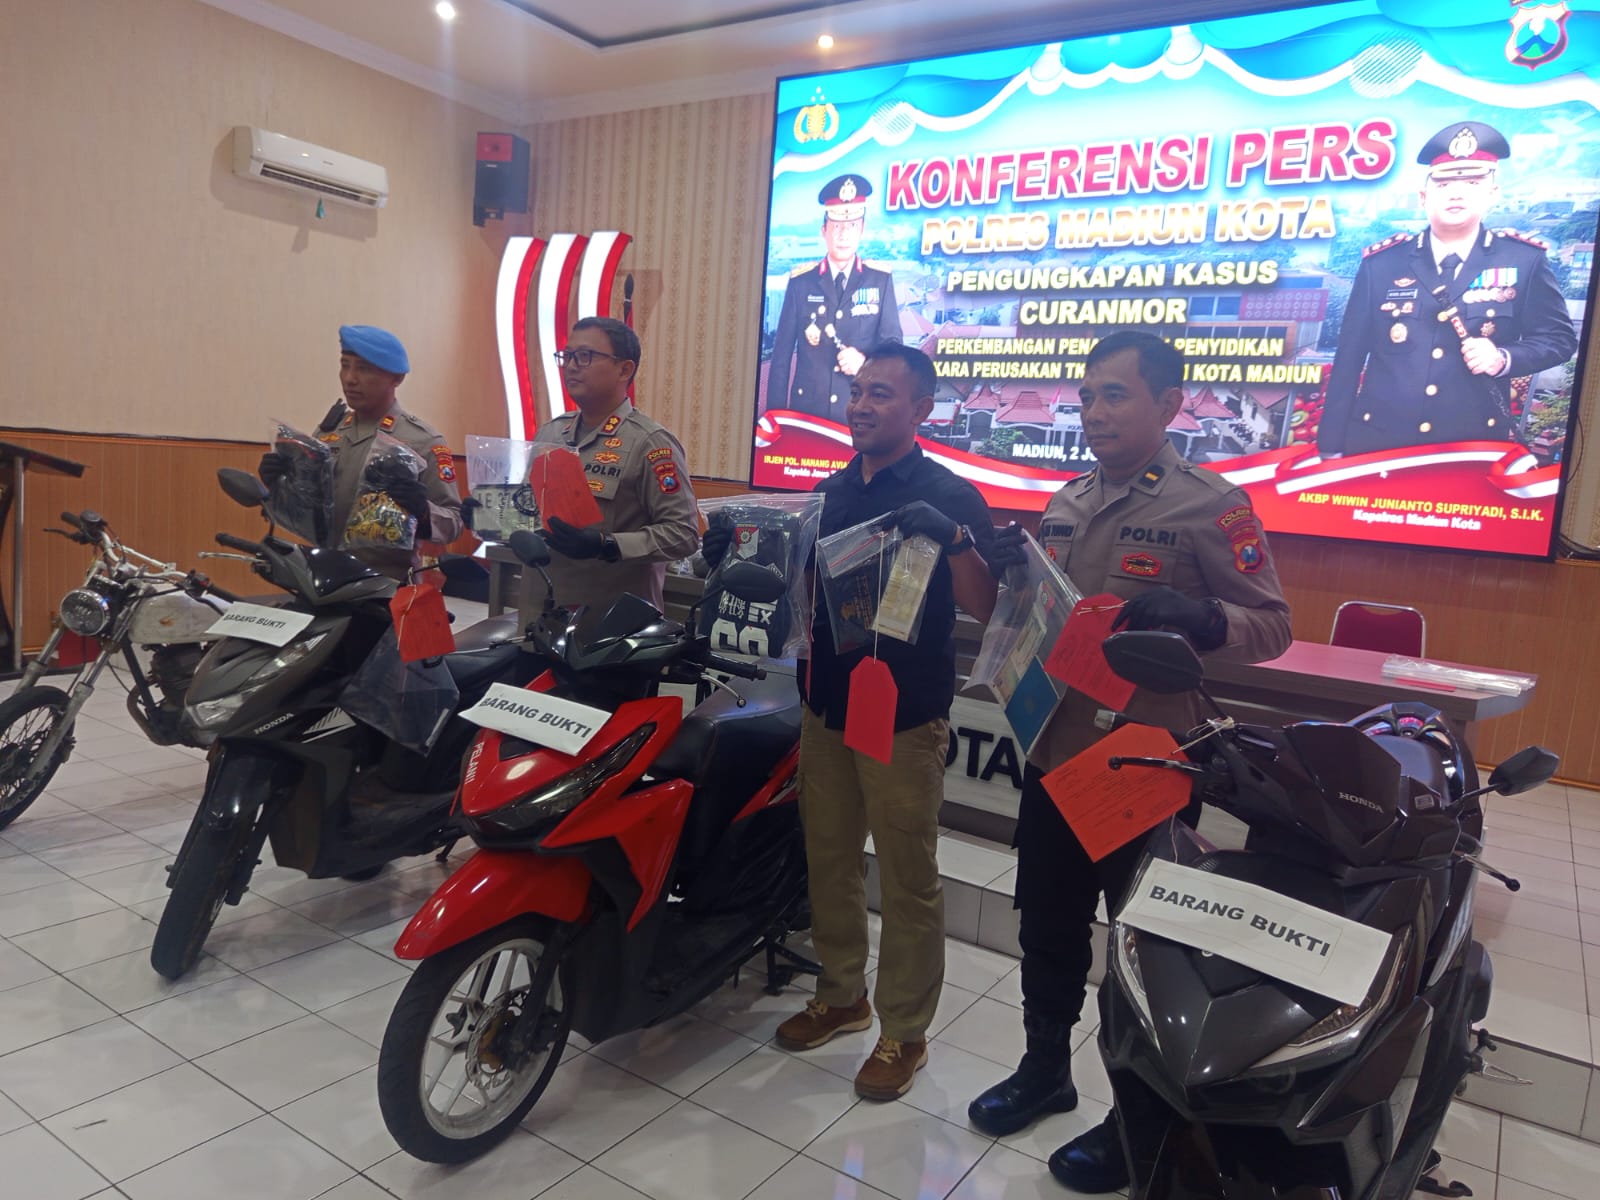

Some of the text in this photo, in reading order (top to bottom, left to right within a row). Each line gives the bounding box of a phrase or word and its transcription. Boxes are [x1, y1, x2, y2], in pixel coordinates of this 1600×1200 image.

[886, 119, 1395, 210] KONFERENSI PERS
[922, 197, 1336, 254] POLRES MADIUN KOTA
[947, 260, 1278, 292] PENGUNGKAPAN KASUS
[1019, 298, 1187, 325] CURANMOR
[937, 338, 1055, 355] PERKEMBANGAN
[1174, 338, 1283, 356] PENYIDIKAN
[972, 361, 1061, 379] PERUSAKAN
[1192, 364, 1242, 382] KOTA
[1246, 365, 1321, 383] MADIUN
[764, 455, 784, 465] IRJEN
[784, 456, 799, 466] POL.
[801, 457, 829, 469] NANANG
[1012, 444, 1066, 462] MADIUN,
[1069, 446, 1079, 460] 2
[584, 464, 621, 478] POLRI
[1298, 492, 1544, 522] AKBP WIWIN JUNIANTO SUPRIYADI, S.I.K.
[1353, 509, 1481, 530] Kapolres Madiun Kota
[1119, 525, 1177, 546] POLRI
[223, 614, 286, 629] BARANG BUKTI
[254, 712, 294, 735] HONDA
[479, 697, 593, 738] BARANG BUKTI
[1337, 792, 1384, 814] HONDA
[1149, 885, 1331, 957] BARANG BUKTI
